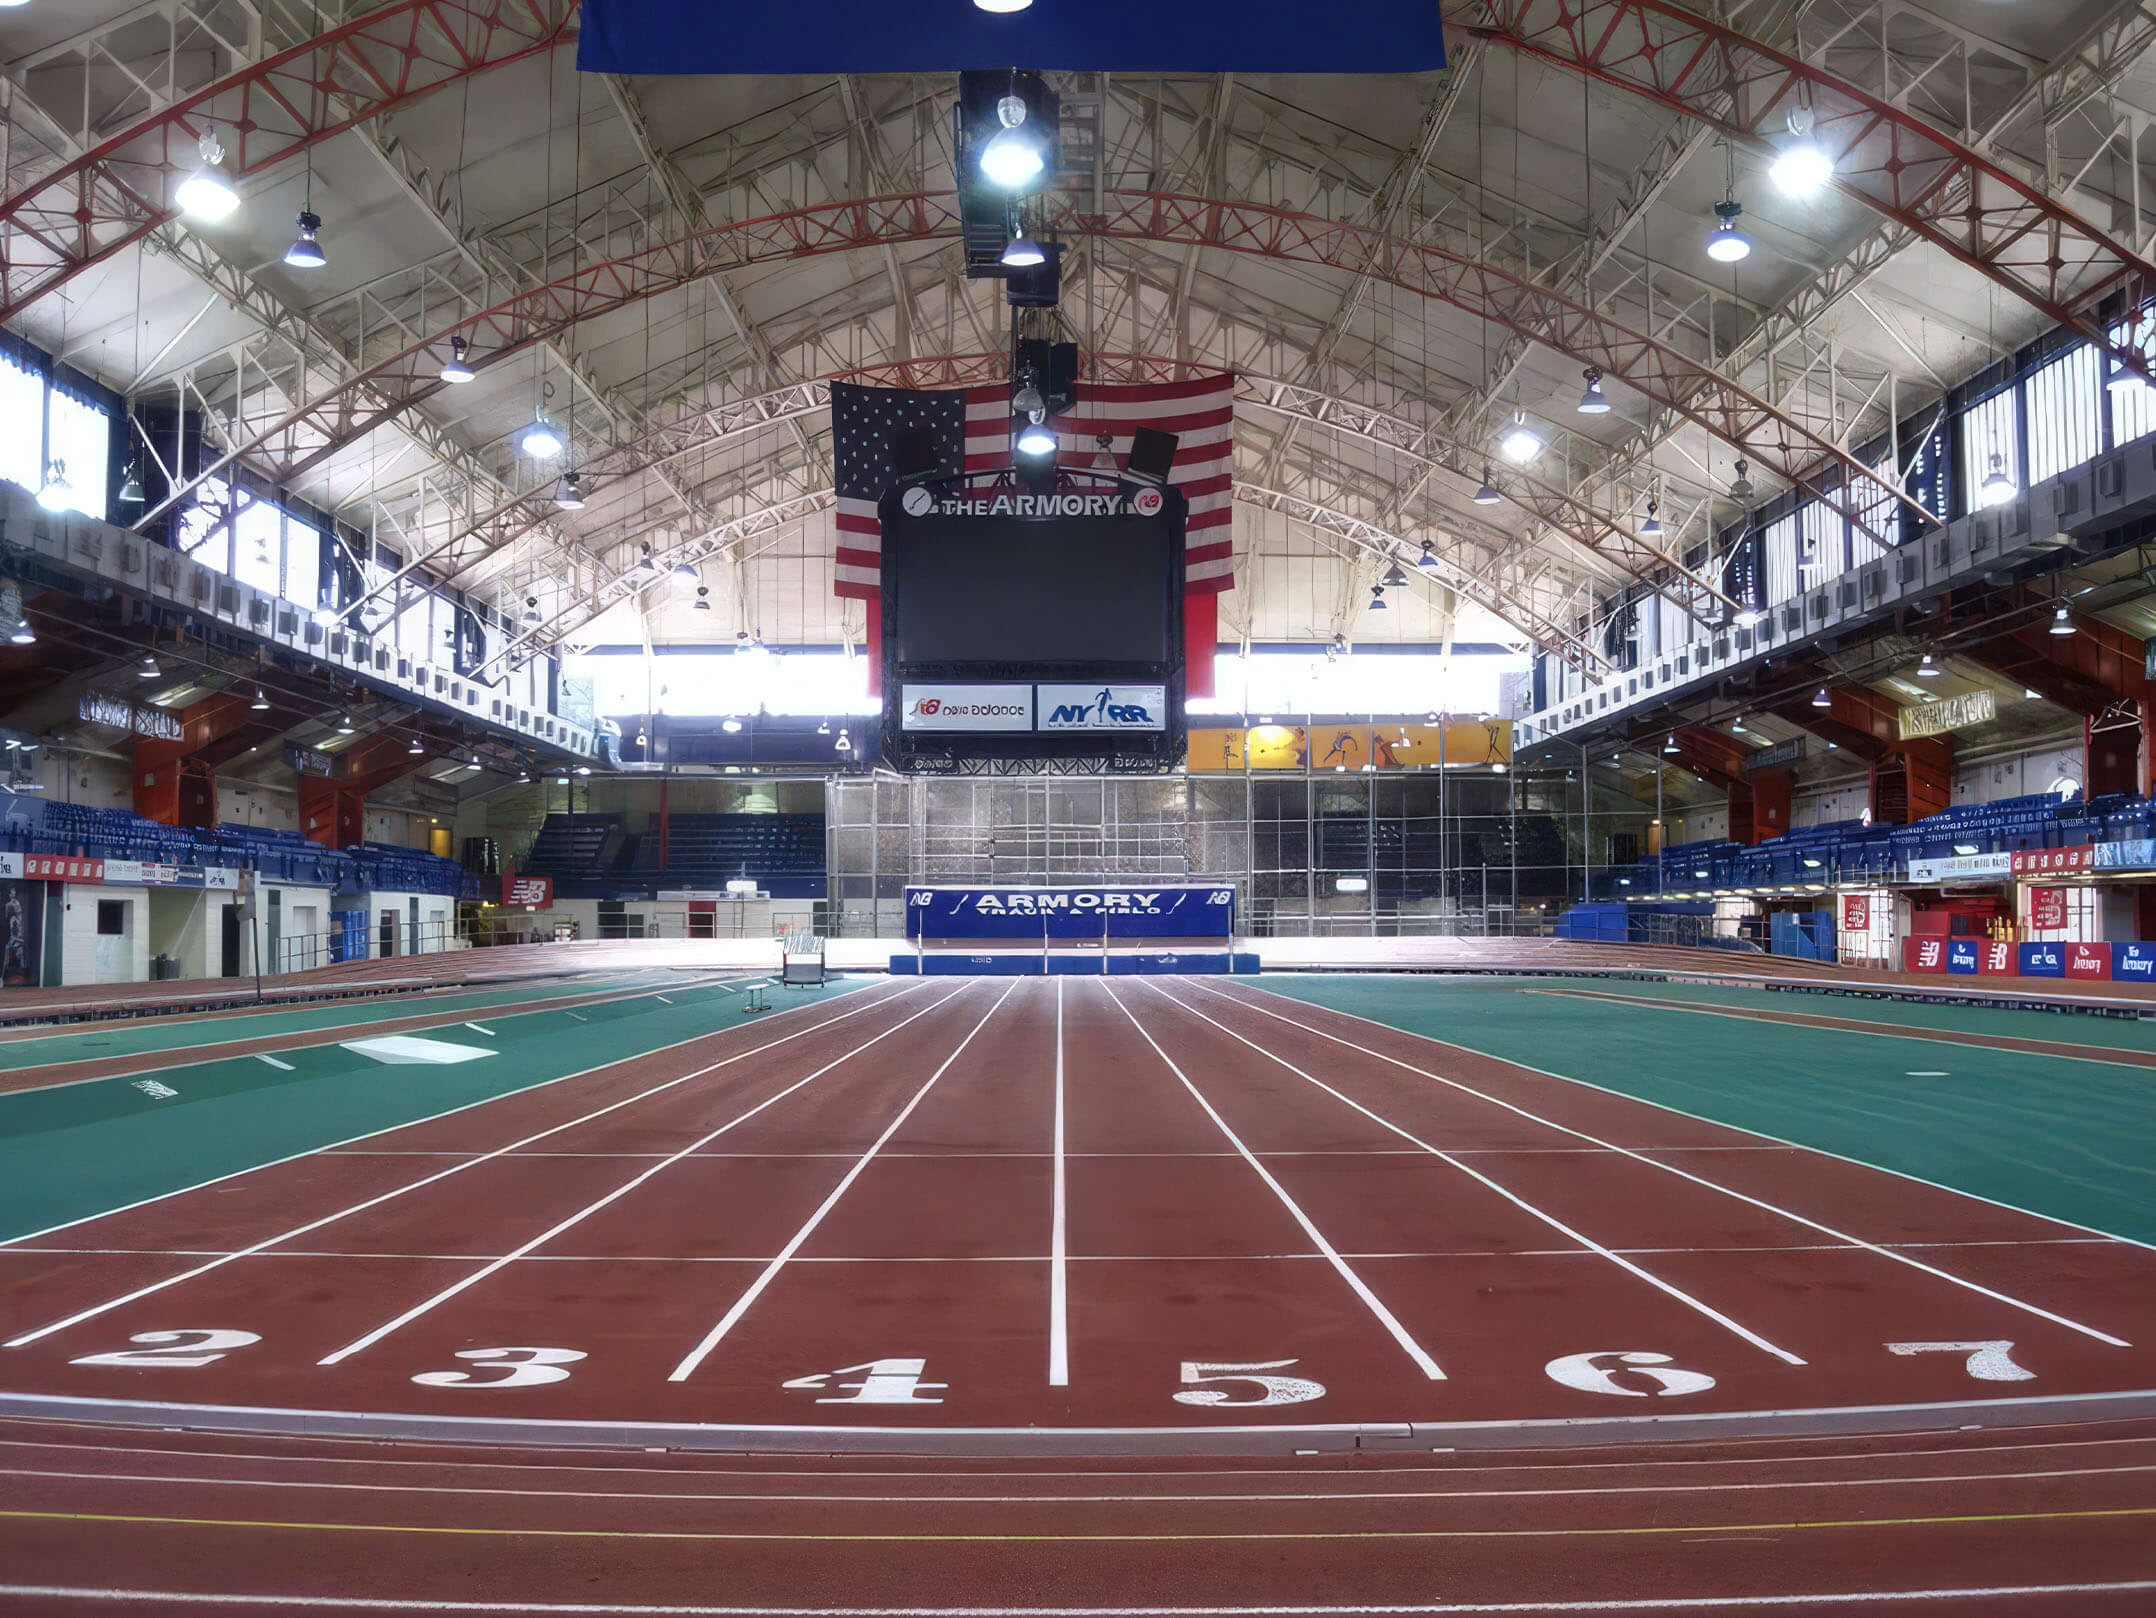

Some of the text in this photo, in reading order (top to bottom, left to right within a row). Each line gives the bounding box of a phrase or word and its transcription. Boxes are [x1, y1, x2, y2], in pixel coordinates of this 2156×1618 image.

[941, 499, 989, 516] THE
[990, 494, 1123, 516] ARMORY
[976, 893, 1161, 908] ARMORY
[68, 1330, 262, 1368] 2
[411, 1346, 588, 1388] 3
[1884, 1340, 2038, 1382] 7
[782, 1359, 949, 1404] 4
[1173, 1358, 1327, 1407] 5
[1545, 1352, 1716, 1397] 6
